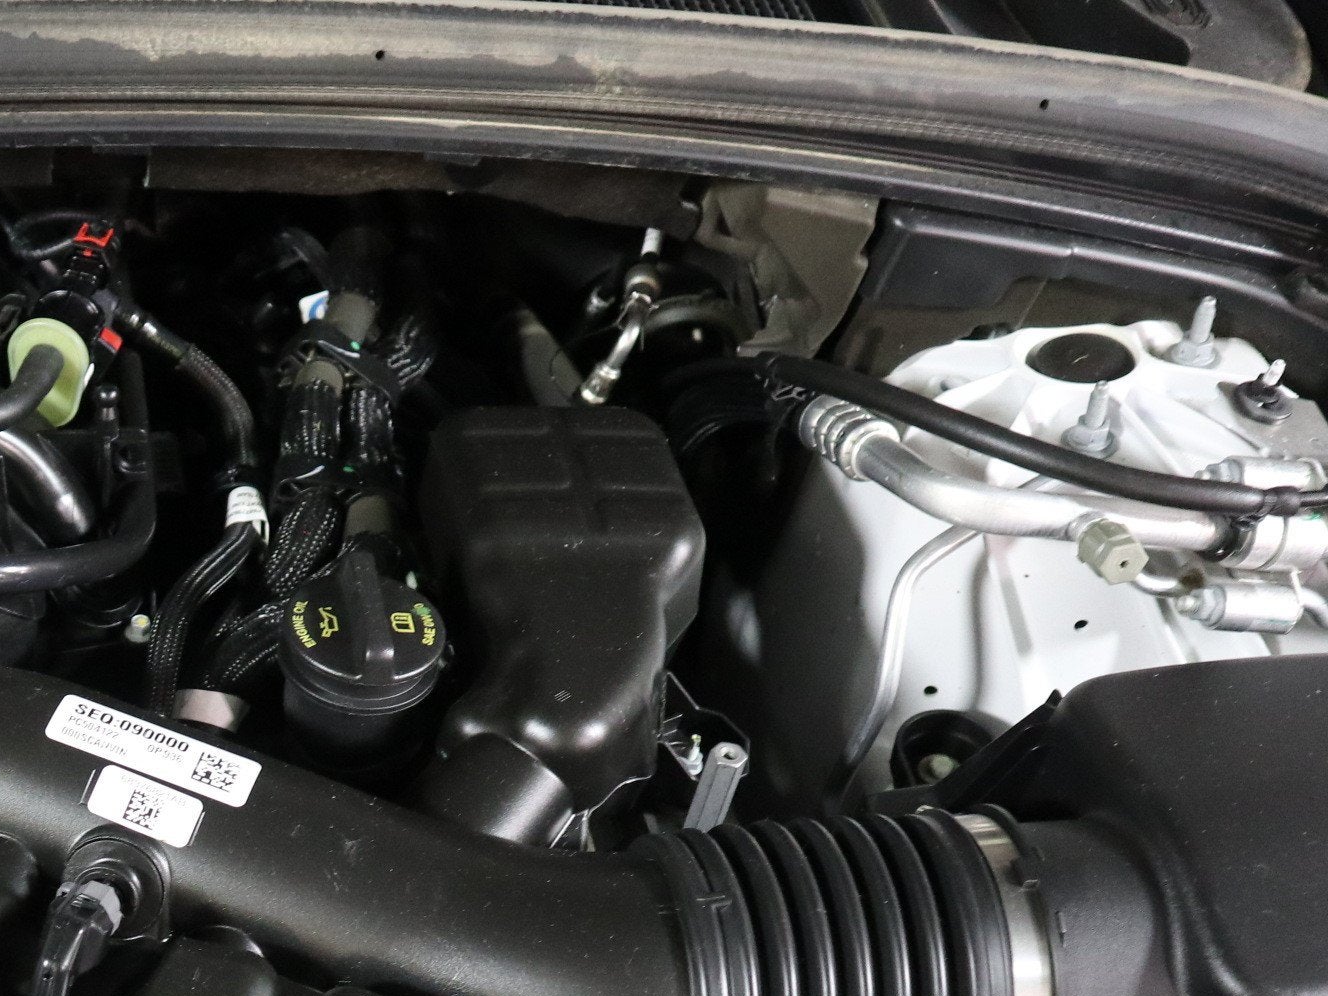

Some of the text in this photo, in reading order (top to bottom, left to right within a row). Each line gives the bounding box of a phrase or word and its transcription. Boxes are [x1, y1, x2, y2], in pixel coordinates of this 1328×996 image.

[292, 600, 317, 648] ENGINE OIL
[421, 627, 436, 646] SAE
[75, 703, 190, 752] SEQ:090000
